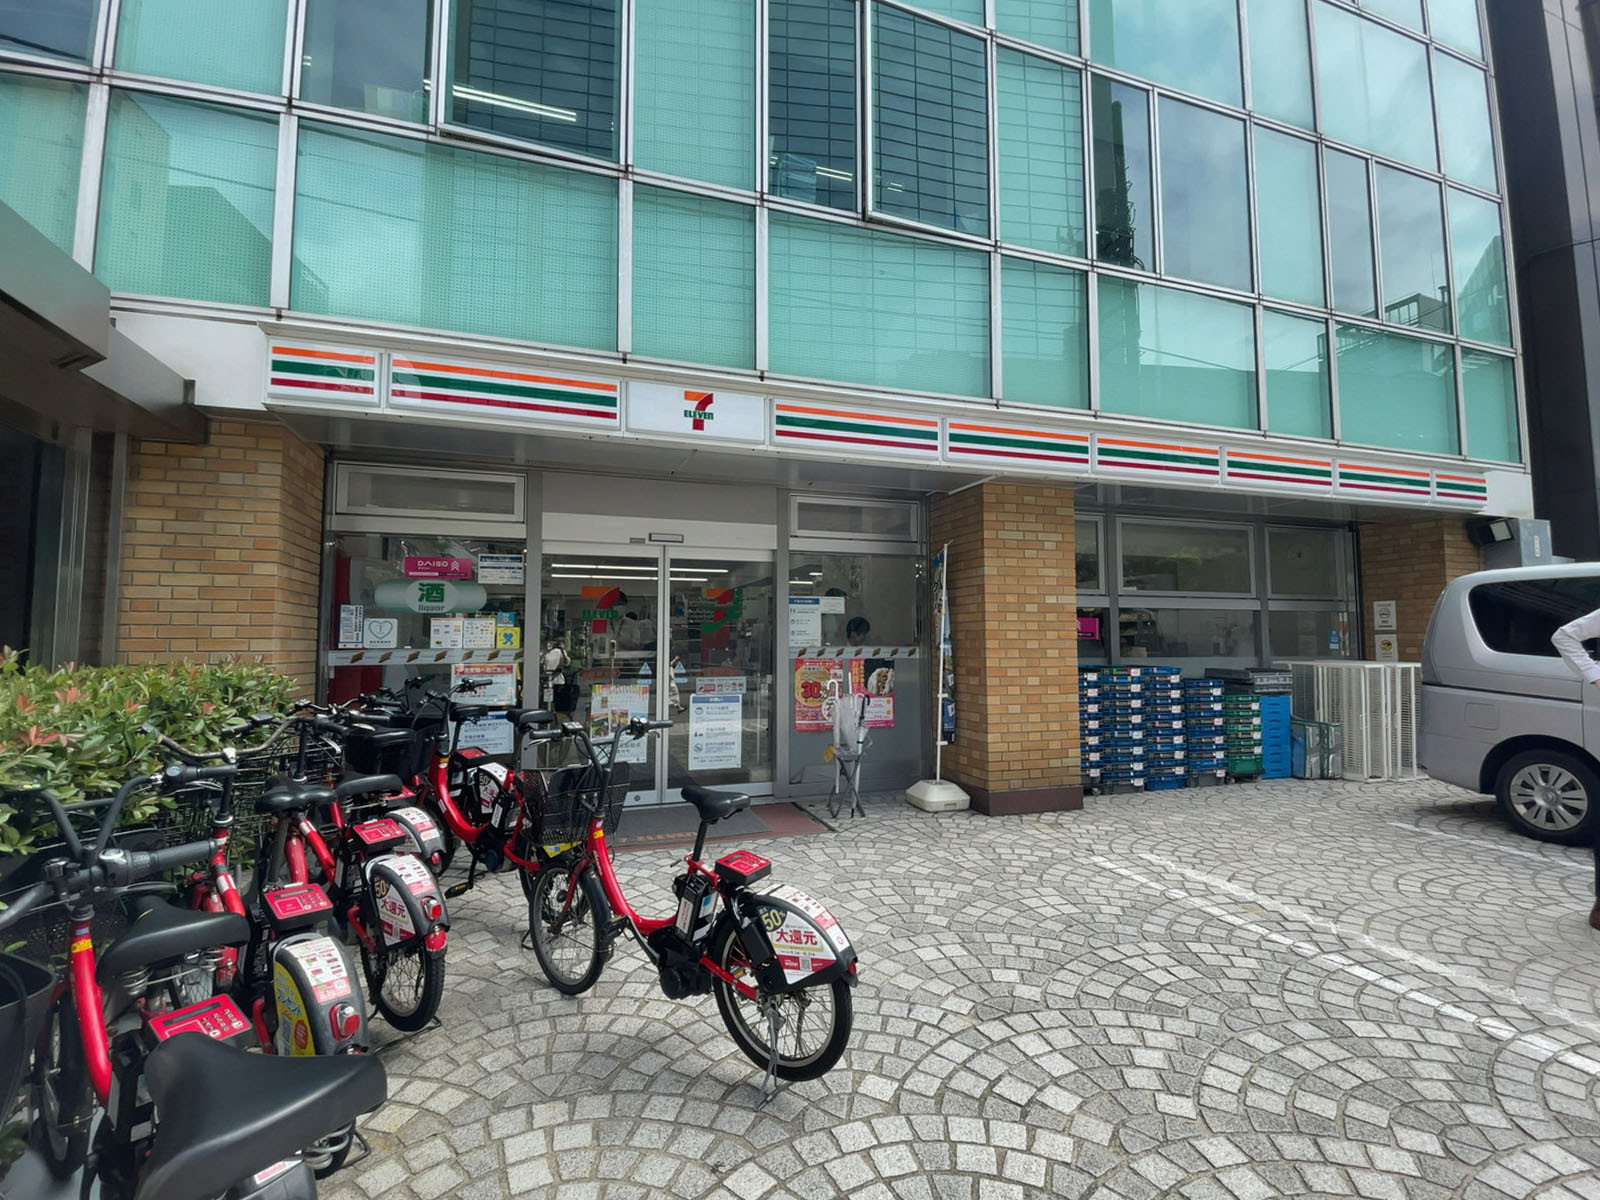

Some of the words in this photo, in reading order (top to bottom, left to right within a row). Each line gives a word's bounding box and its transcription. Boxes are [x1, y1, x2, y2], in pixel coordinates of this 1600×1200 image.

[684, 390, 714, 431] 7
[417, 560, 449, 568] DAISO
[418, 582, 445, 603] 酒
[418, 604, 446, 612] liquor
[776, 928, 818, 946] 大還元
